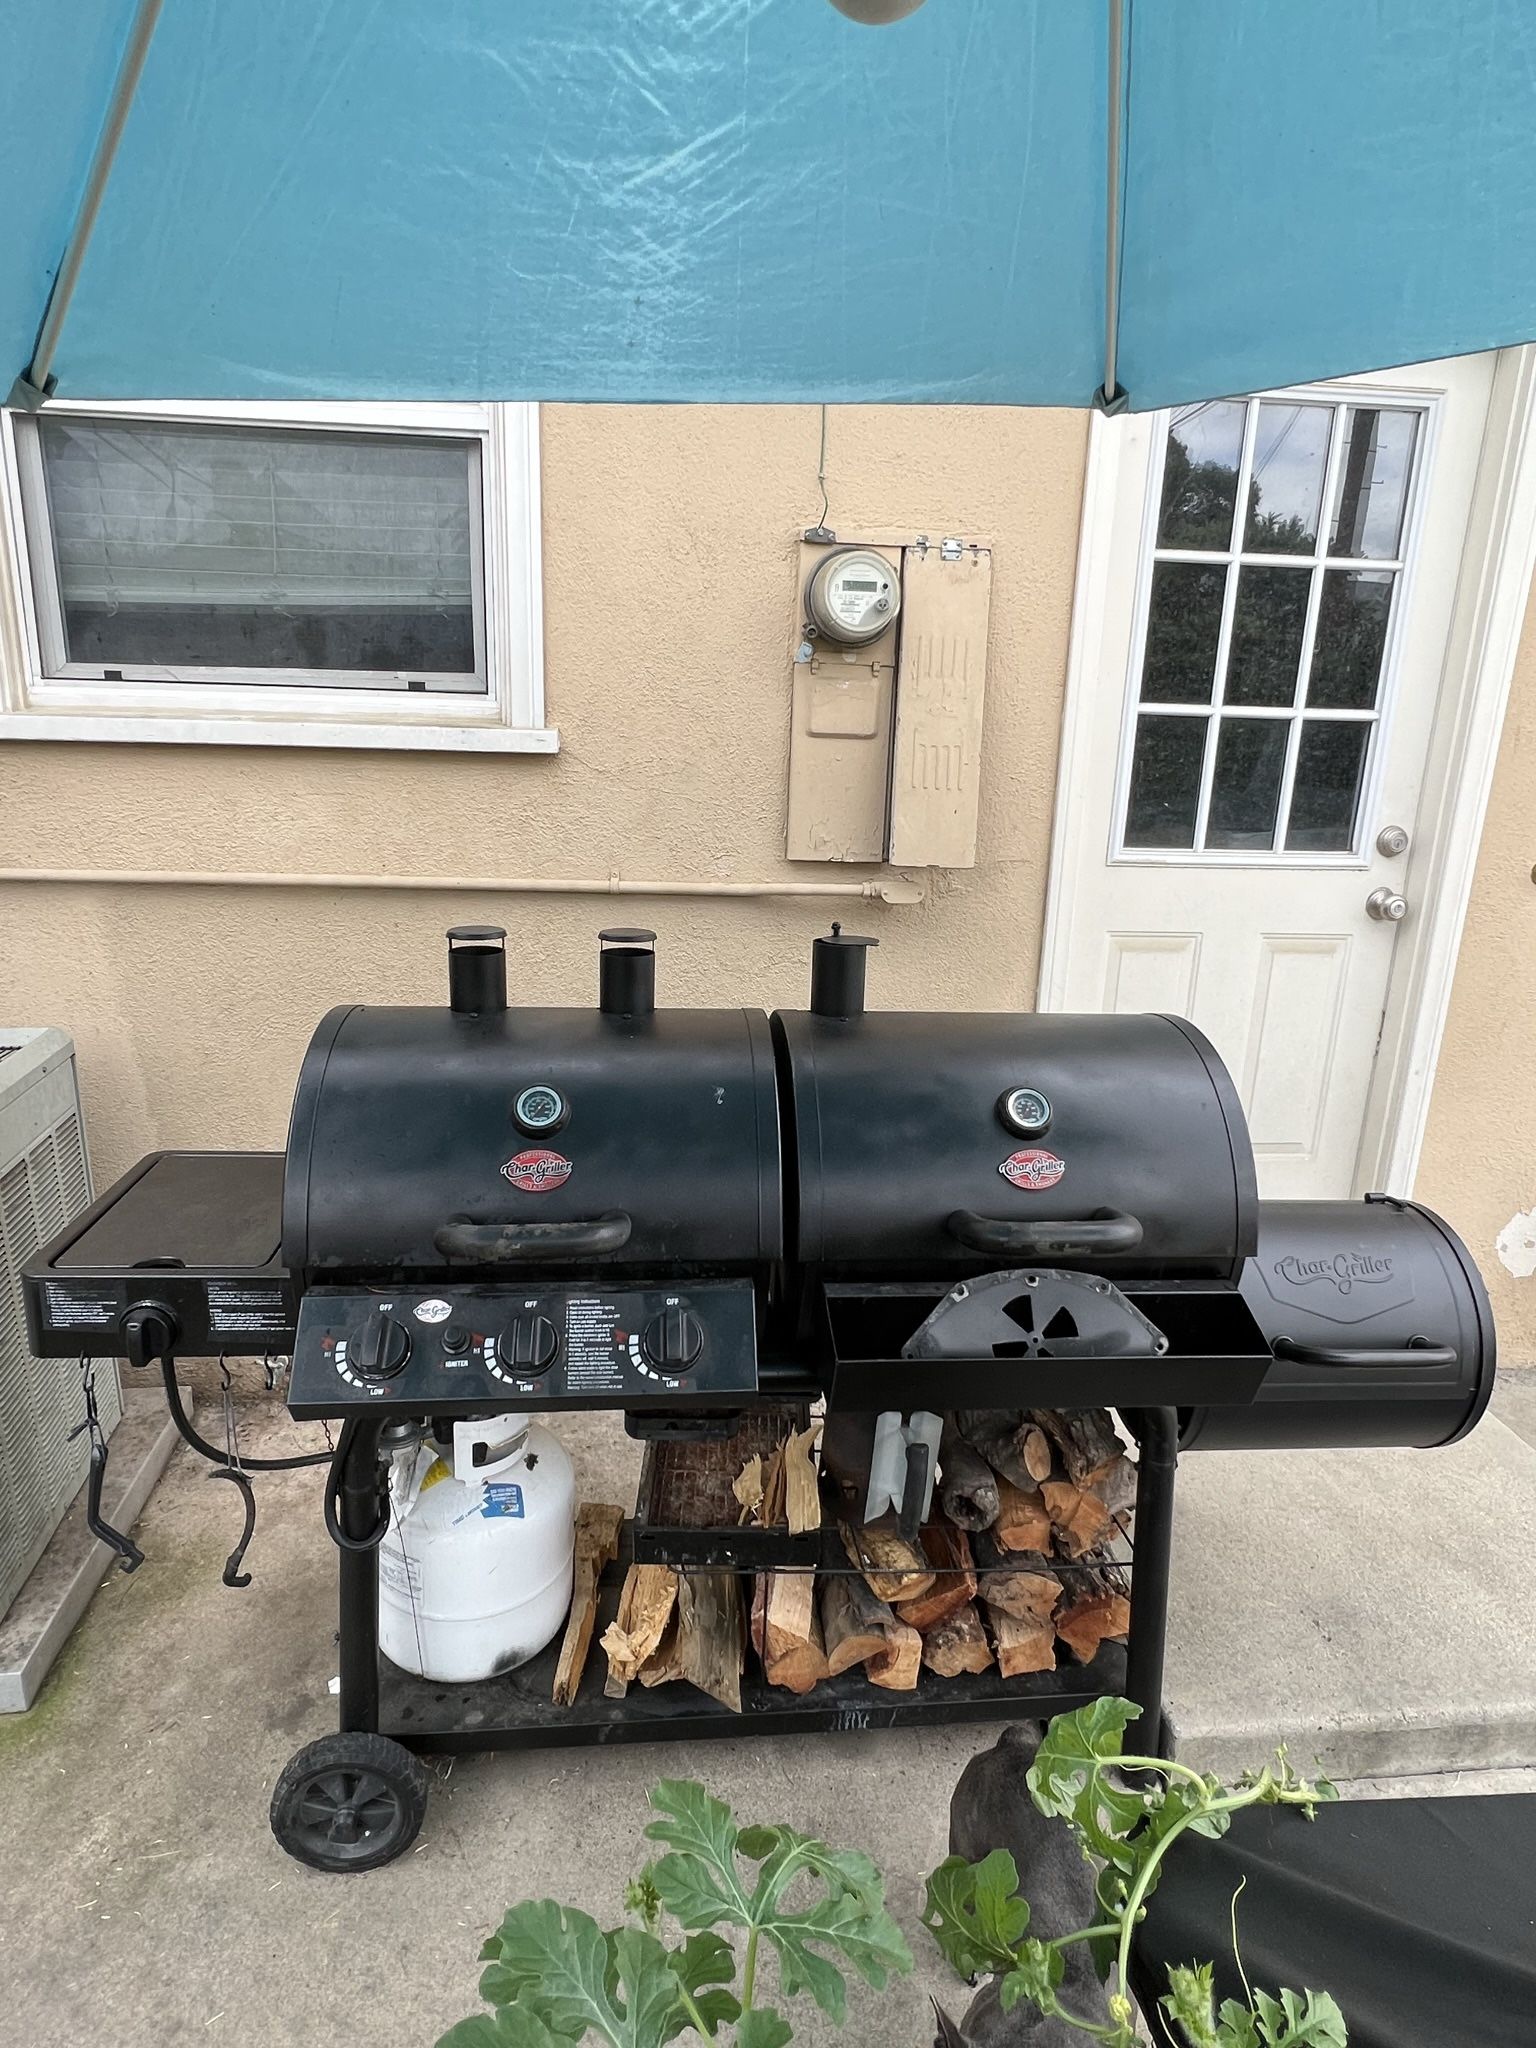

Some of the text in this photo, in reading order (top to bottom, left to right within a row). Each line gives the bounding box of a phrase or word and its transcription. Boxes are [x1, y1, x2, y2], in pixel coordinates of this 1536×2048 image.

[379, 1303, 393, 1311] OFF
[525, 1300, 538, 1308] OFF
[666, 1380, 680, 1388] LOW
[370, 1388, 385, 1396] LOW
